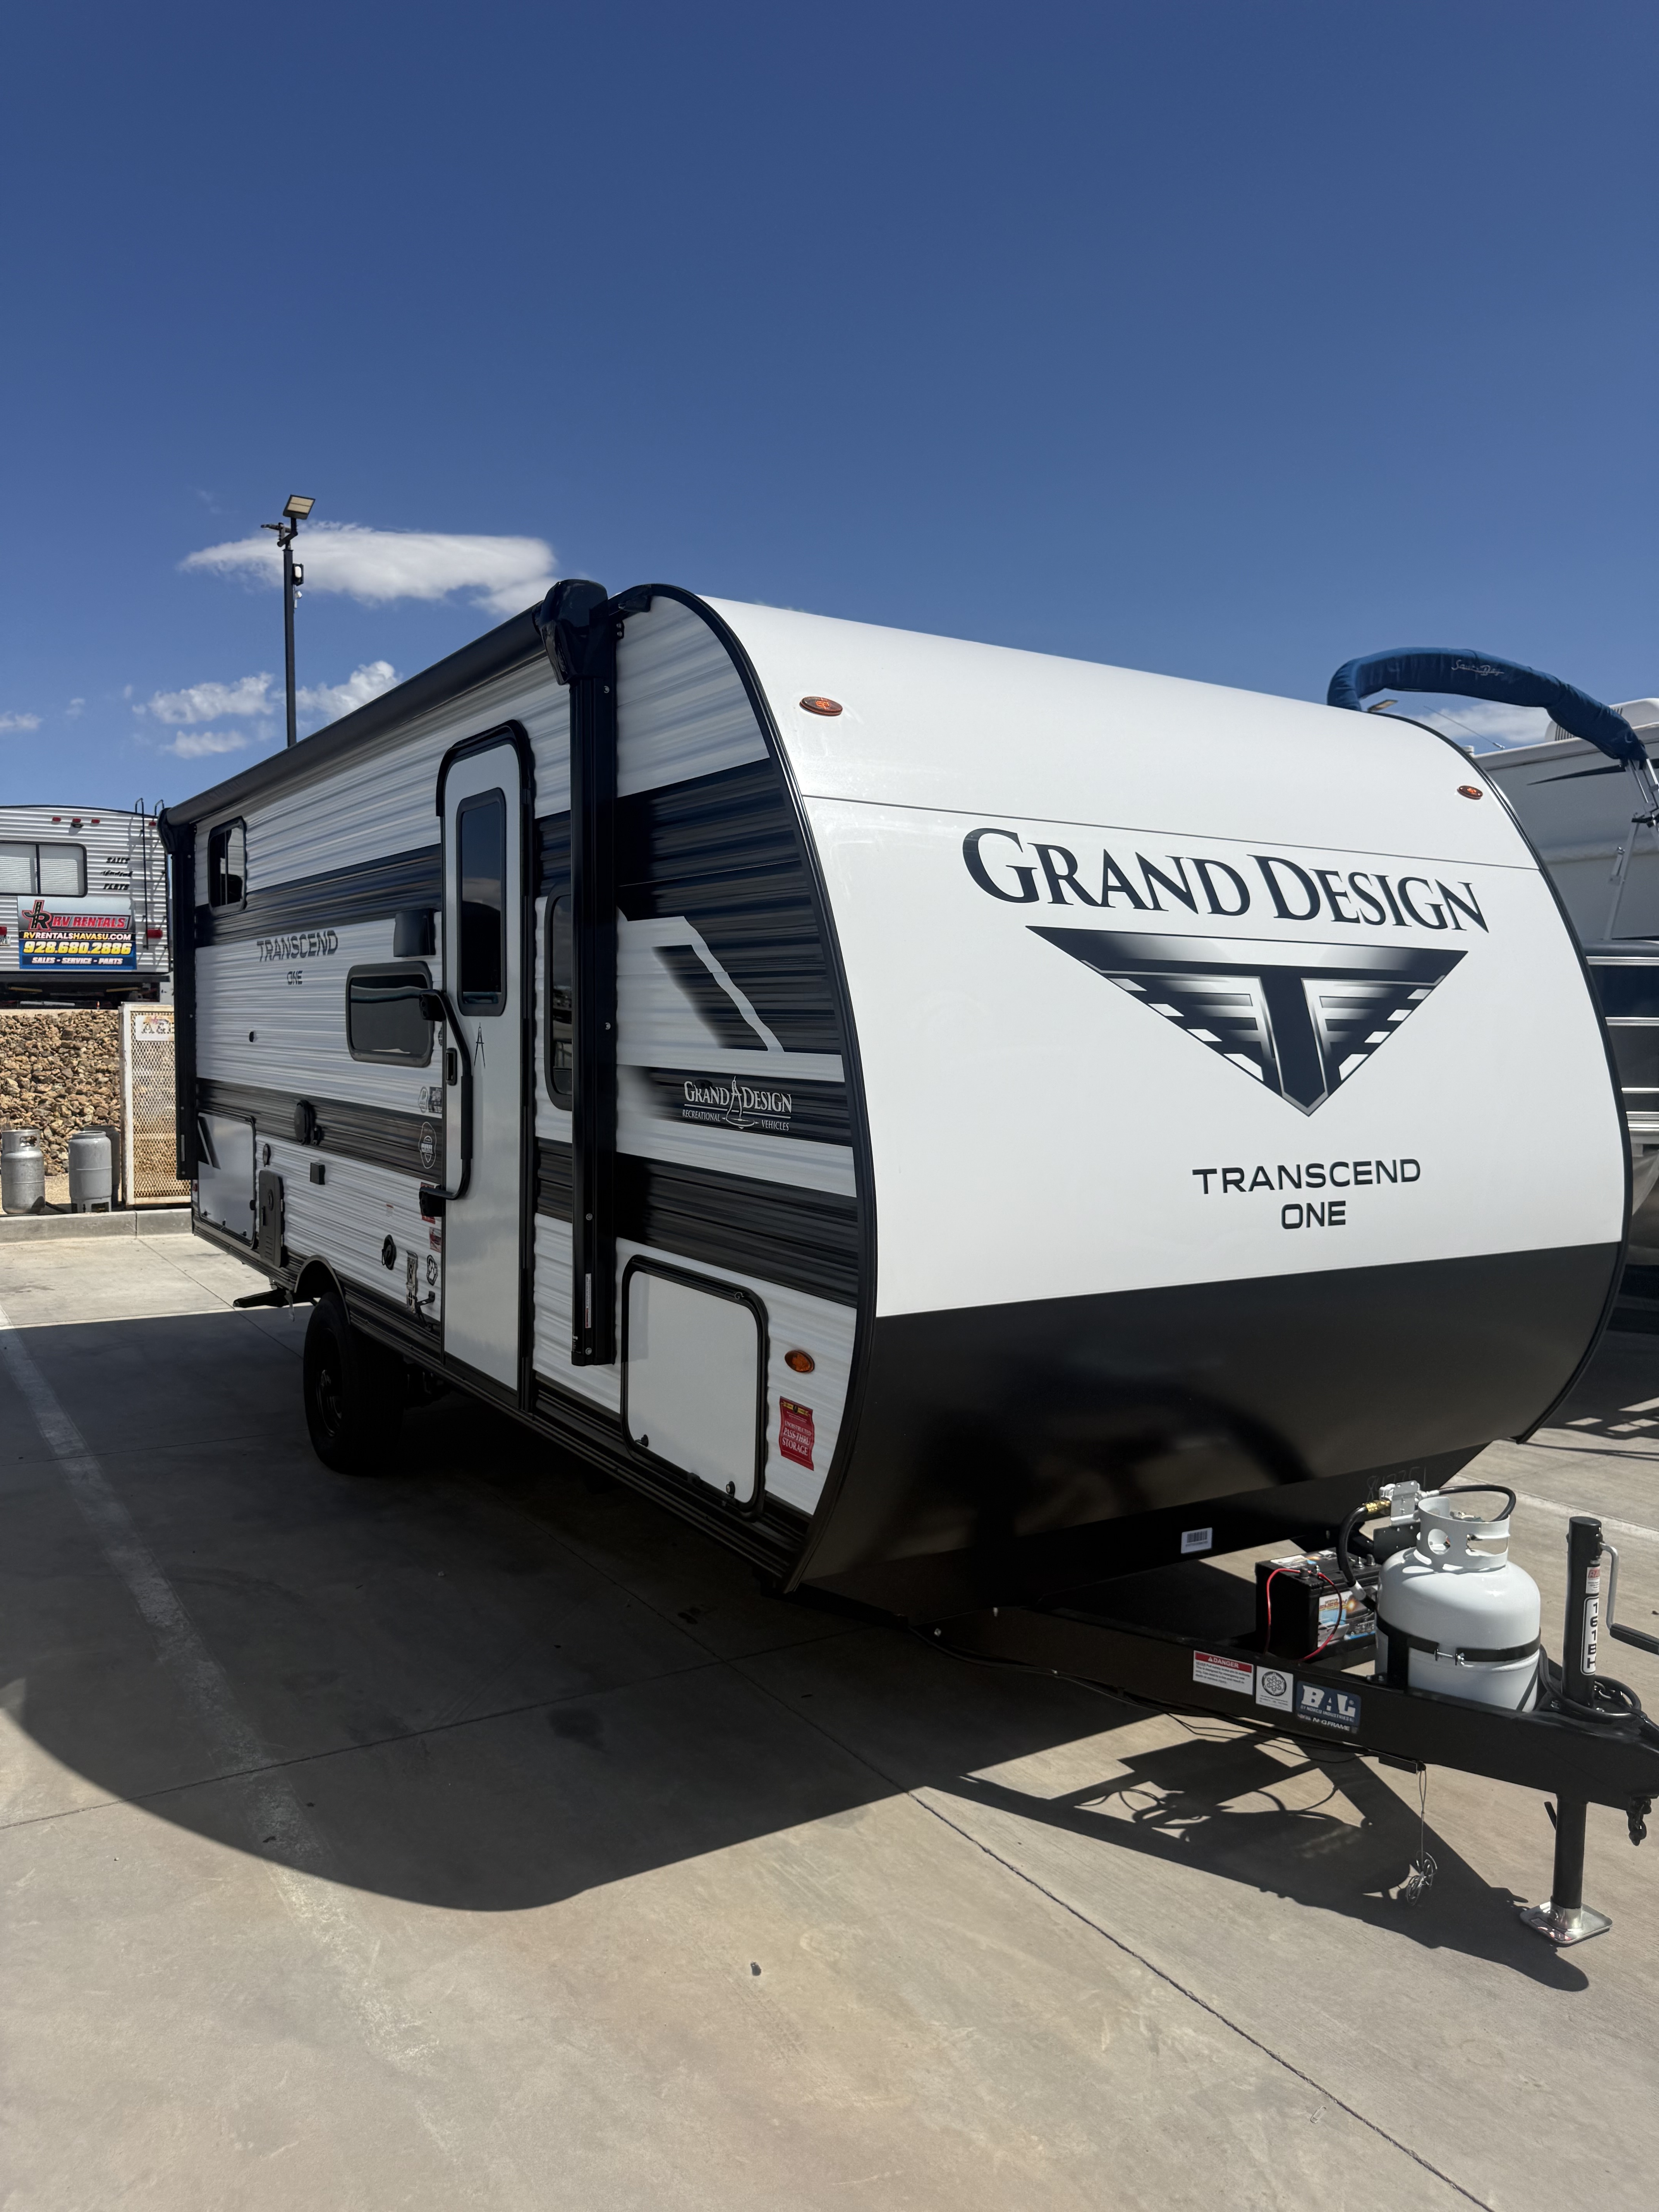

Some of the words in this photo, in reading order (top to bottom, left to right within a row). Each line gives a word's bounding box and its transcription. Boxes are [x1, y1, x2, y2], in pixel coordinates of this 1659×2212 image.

[962, 828, 1251, 915] GRAND
[1246, 854, 1489, 933] DESIGN
[52, 915, 72, 927] RV
[72, 916, 126, 928] RENTALS
[23, 932, 132, 941] RVRENTALSHAVASU.COM
[23, 941, 132, 955] 928.680.2886
[257, 930, 338, 962] TRANSCEND
[287, 970, 303, 985] ONE
[684, 1080, 730, 1106] GRAND
[740, 1086, 792, 1113] DESIGN
[682, 1109, 721, 1122] RECREATIONAL
[761, 1119, 789, 1131] VEHICLES
[1192, 1159, 1421, 1195] TRANSCEND
[1281, 1200, 1346, 1230] ONE
[783, 1427, 811, 1445] PASS-THRU
[782, 1437, 808, 1456] STORAGE
[1213, 1657, 1239, 1669] DANGER
[1301, 1685, 1356, 1717] BAL
